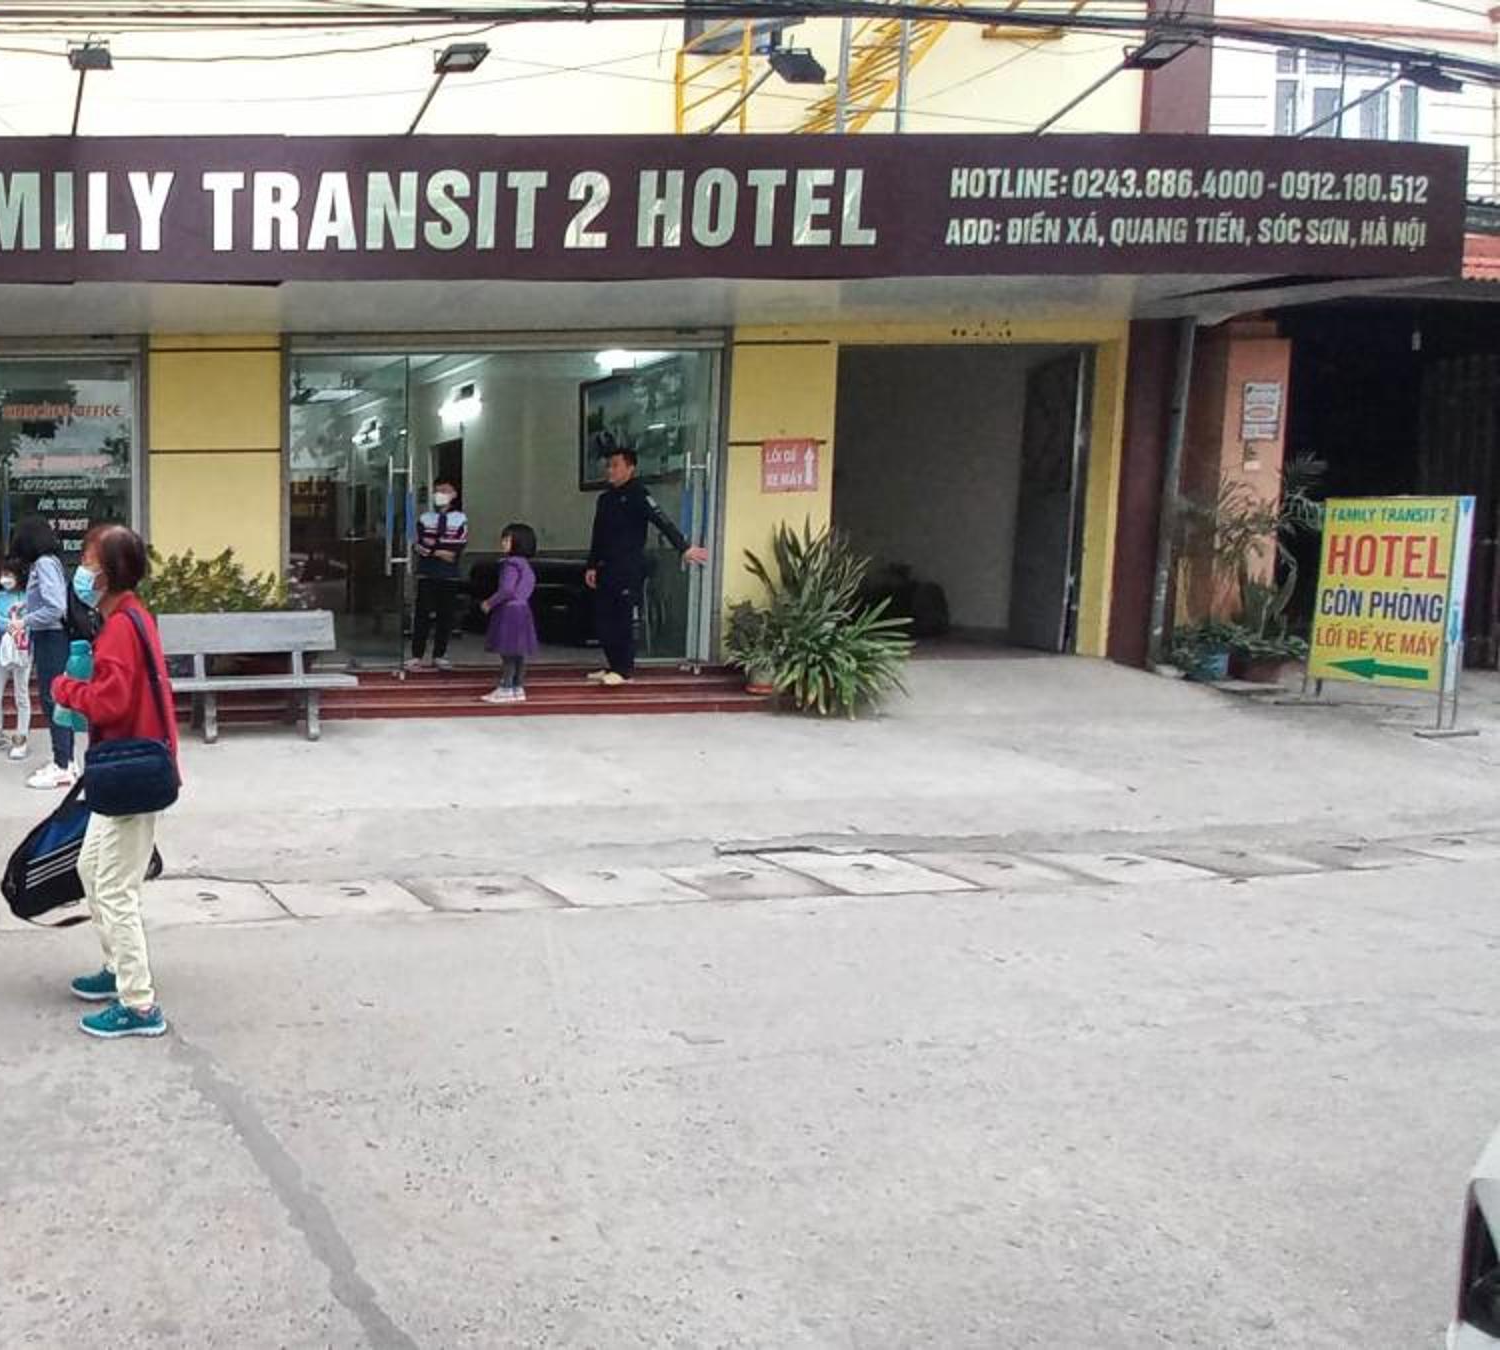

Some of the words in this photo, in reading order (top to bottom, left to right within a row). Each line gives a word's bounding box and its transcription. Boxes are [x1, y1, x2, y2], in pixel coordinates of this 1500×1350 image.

[950, 167, 1068, 199] HOTLINE:
[1280, 170, 1429, 204] 0912.180.512
[202, 169, 548, 251] TRANSIT
[563, 170, 611, 249] 2
[636, 167, 877, 247] HOTEL
[945, 218, 1002, 245] ADD:
[1110, 217, 1189, 247] QUANG
[1257, 212, 1302, 245] SÓC
[1331, 506, 1377, 523] FAMILY
[1381, 506, 1436, 524] TRANSIT
[1326, 533, 1447, 580] HOTEL
[1371, 630, 1397, 653] XE
[1399, 628, 1440, 657] MÁY
